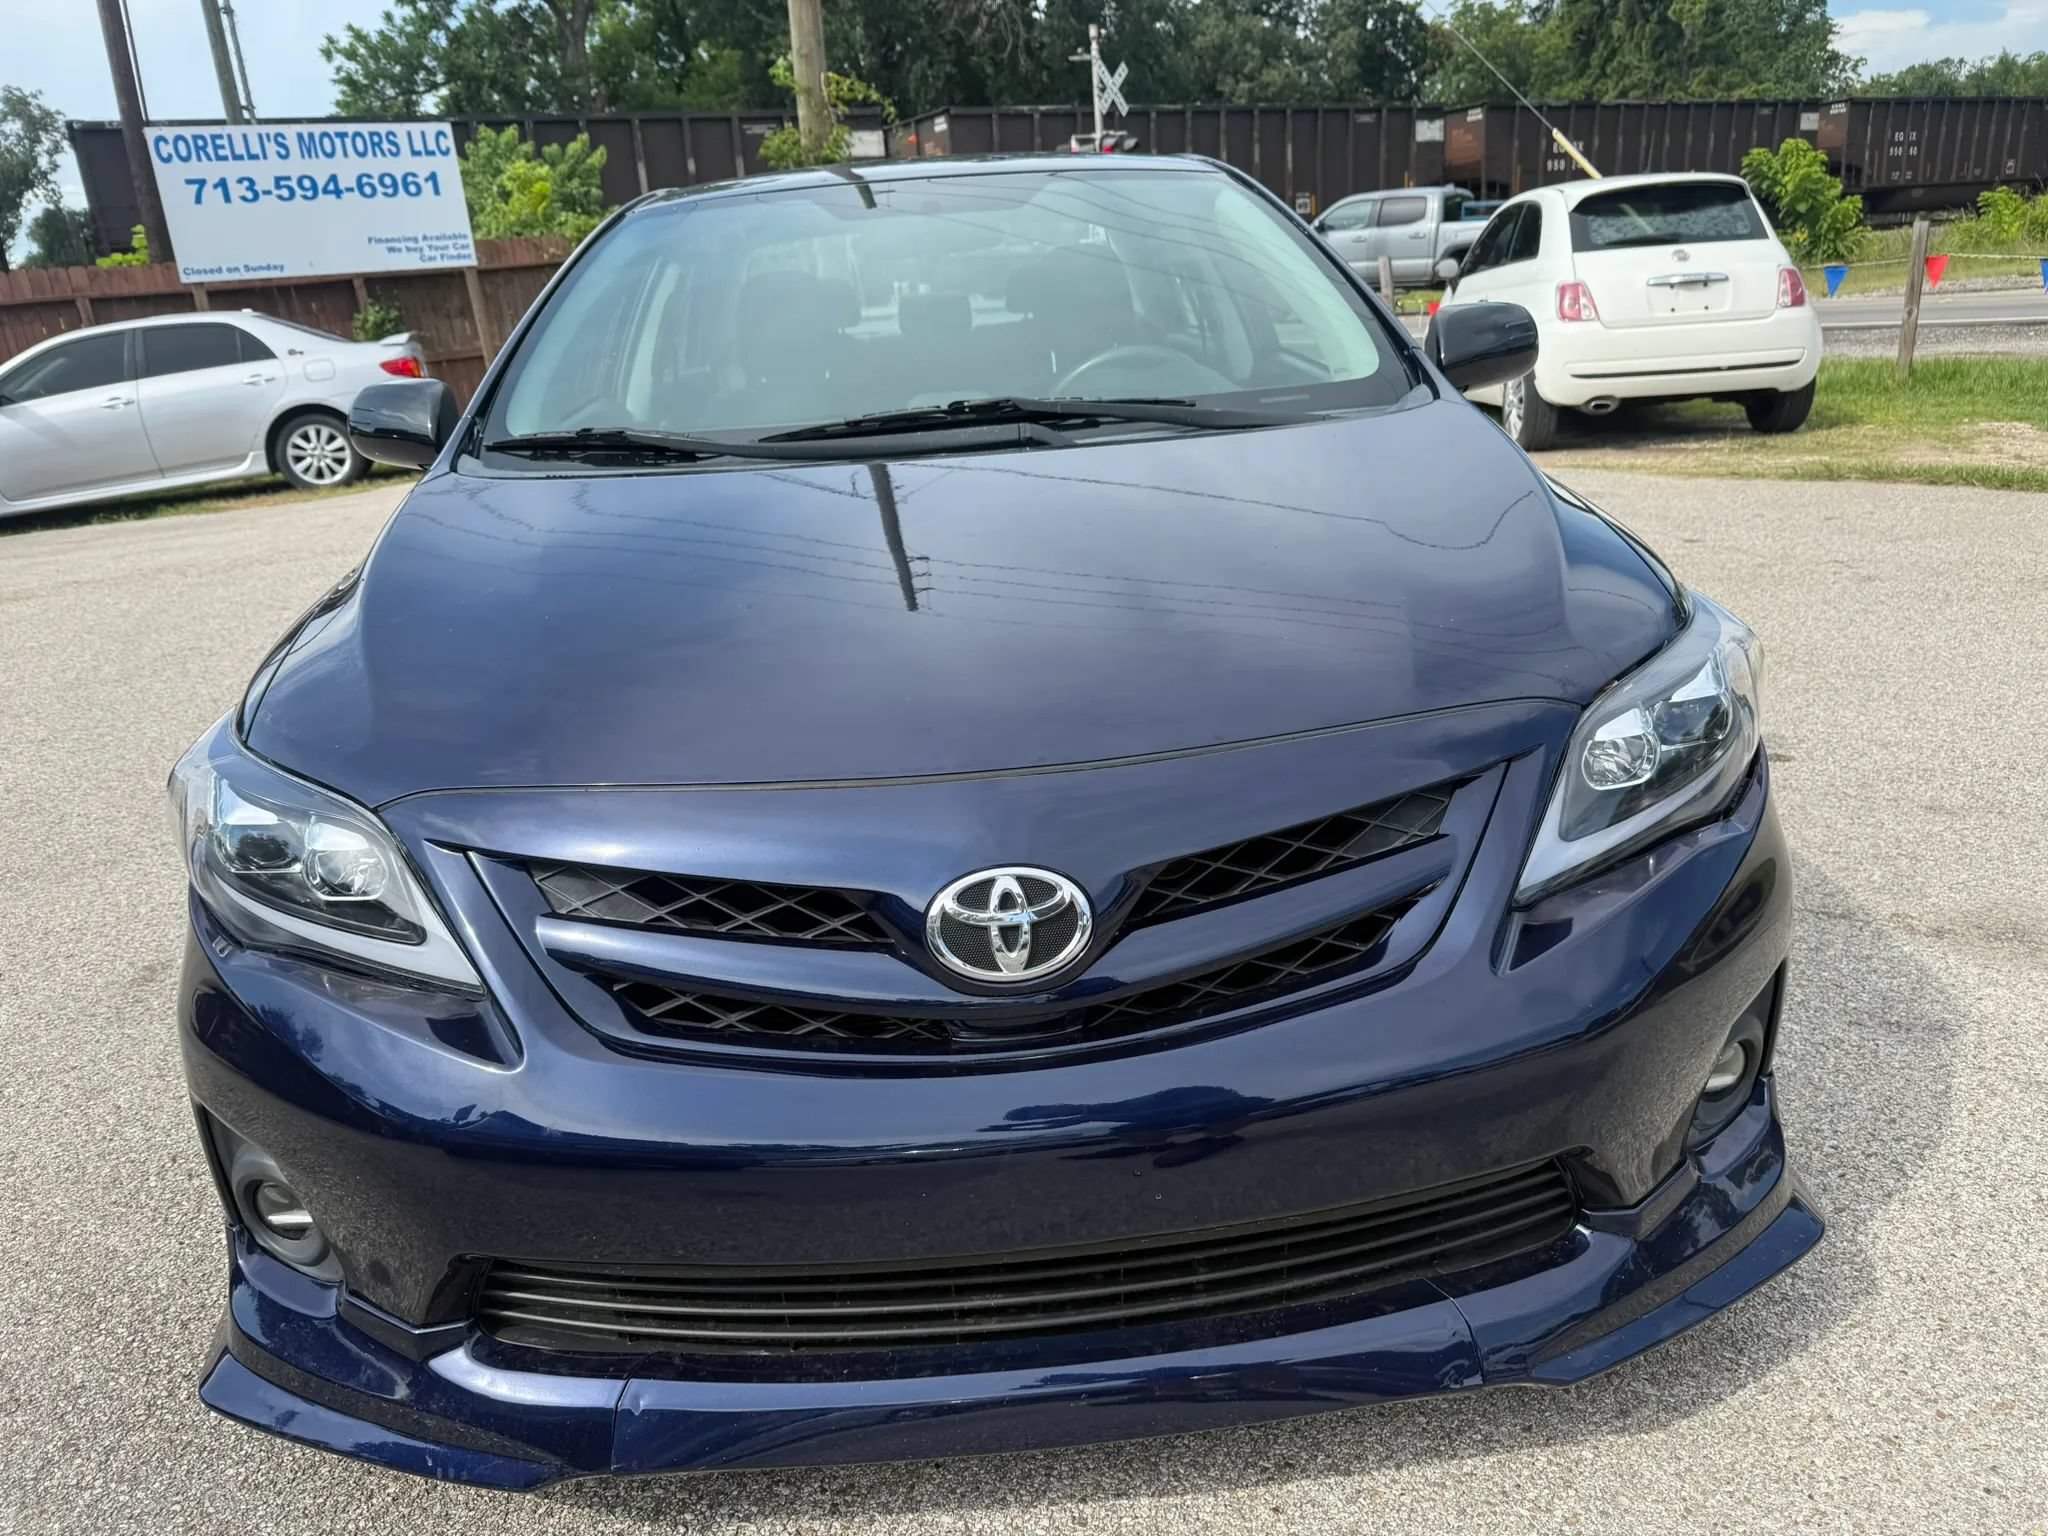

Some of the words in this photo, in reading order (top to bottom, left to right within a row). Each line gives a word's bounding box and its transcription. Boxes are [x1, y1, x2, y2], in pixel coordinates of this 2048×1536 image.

[153, 132, 291, 164] CORELLI'S
[297, 130, 401, 159] MOTORS
[407, 130, 451, 157] LLC
[185, 170, 442, 205] 713-594-6961
[367, 235, 419, 245] Financing
[422, 232, 468, 242] Available
[386, 245, 402, 254] We
[427, 244, 449, 252] Your
[452, 242, 470, 250] Car
[419, 254, 437, 262] Car
[440, 252, 472, 261] Finder
[182, 266, 223, 276] Closed
[243, 263, 285, 273] Sunday
